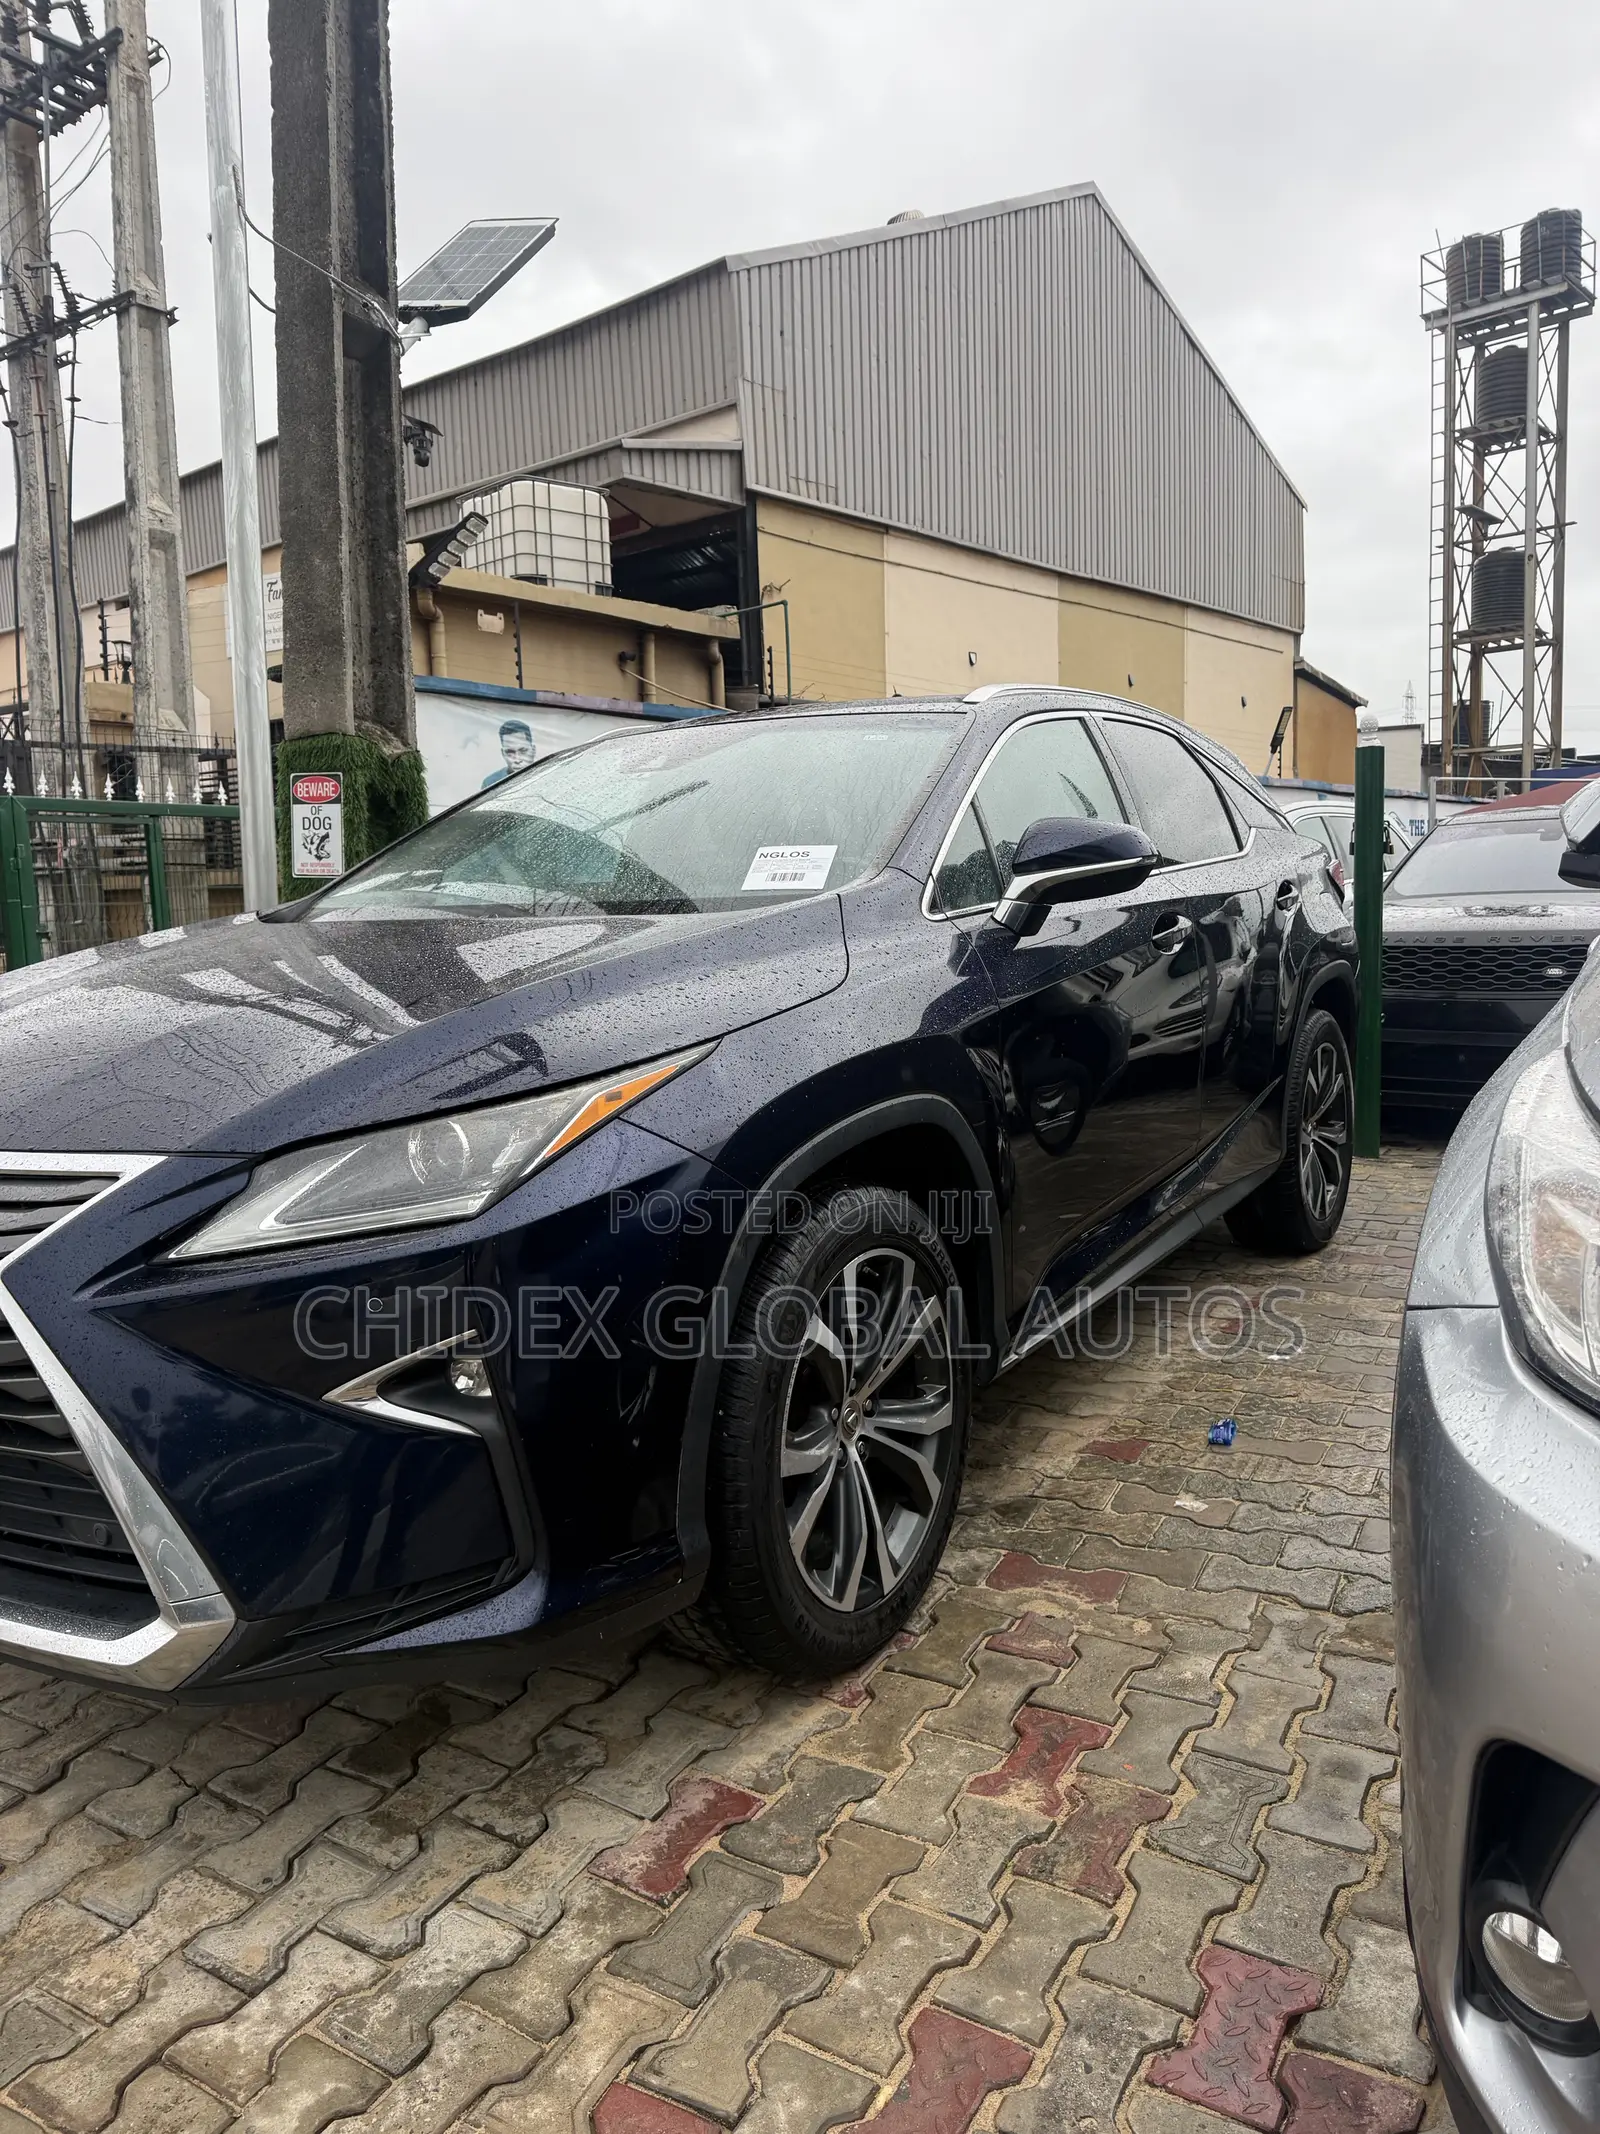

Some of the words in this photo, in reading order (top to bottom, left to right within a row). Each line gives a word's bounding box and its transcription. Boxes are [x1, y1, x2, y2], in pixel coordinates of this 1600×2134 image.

[297, 782, 336, 797] BEWARE
[310, 806, 323, 815] OF
[302, 816, 332, 830] DOG
[1409, 819, 1425, 836] THE
[758, 851, 811, 859] NGLOS
[1487, 934, 1586, 943] ROVER
